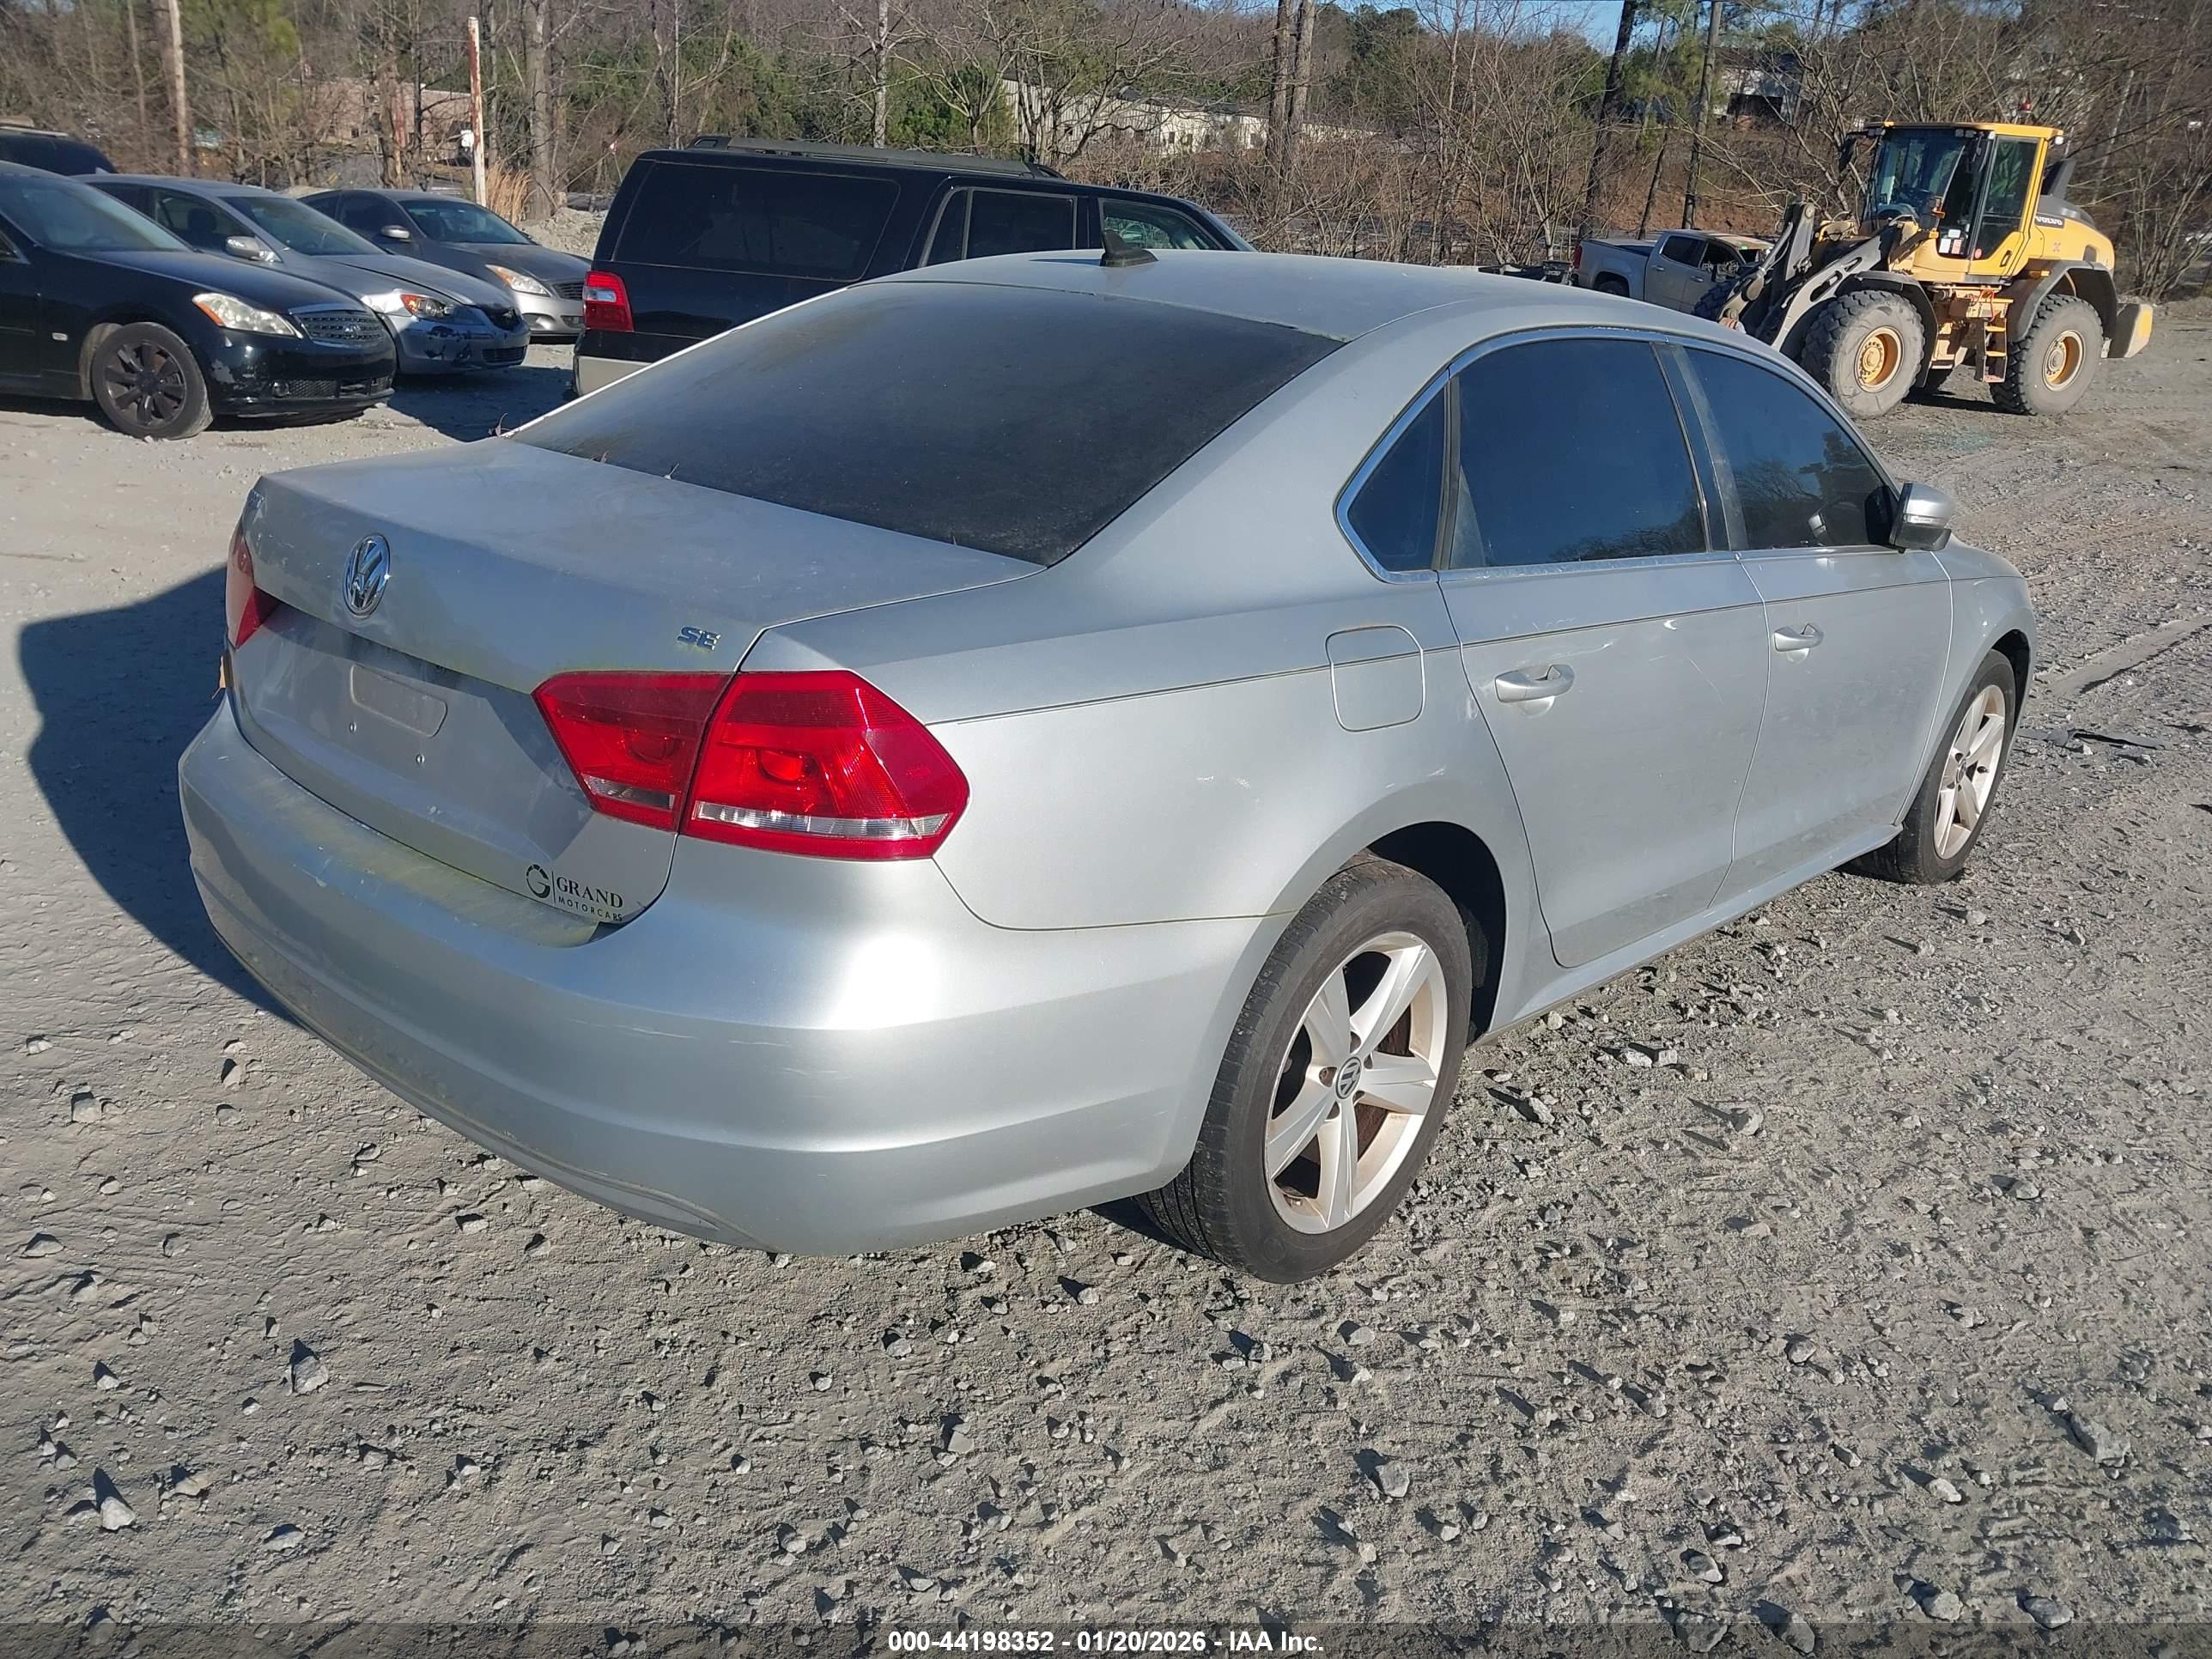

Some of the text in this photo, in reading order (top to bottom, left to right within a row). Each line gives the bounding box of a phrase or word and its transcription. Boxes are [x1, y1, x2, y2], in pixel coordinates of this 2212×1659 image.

[2036, 216, 2063, 225] VOLVO
[677, 626, 721, 651] SE
[556, 877, 623, 908] GRAND
[558, 896, 623, 921] MOTORCARS
